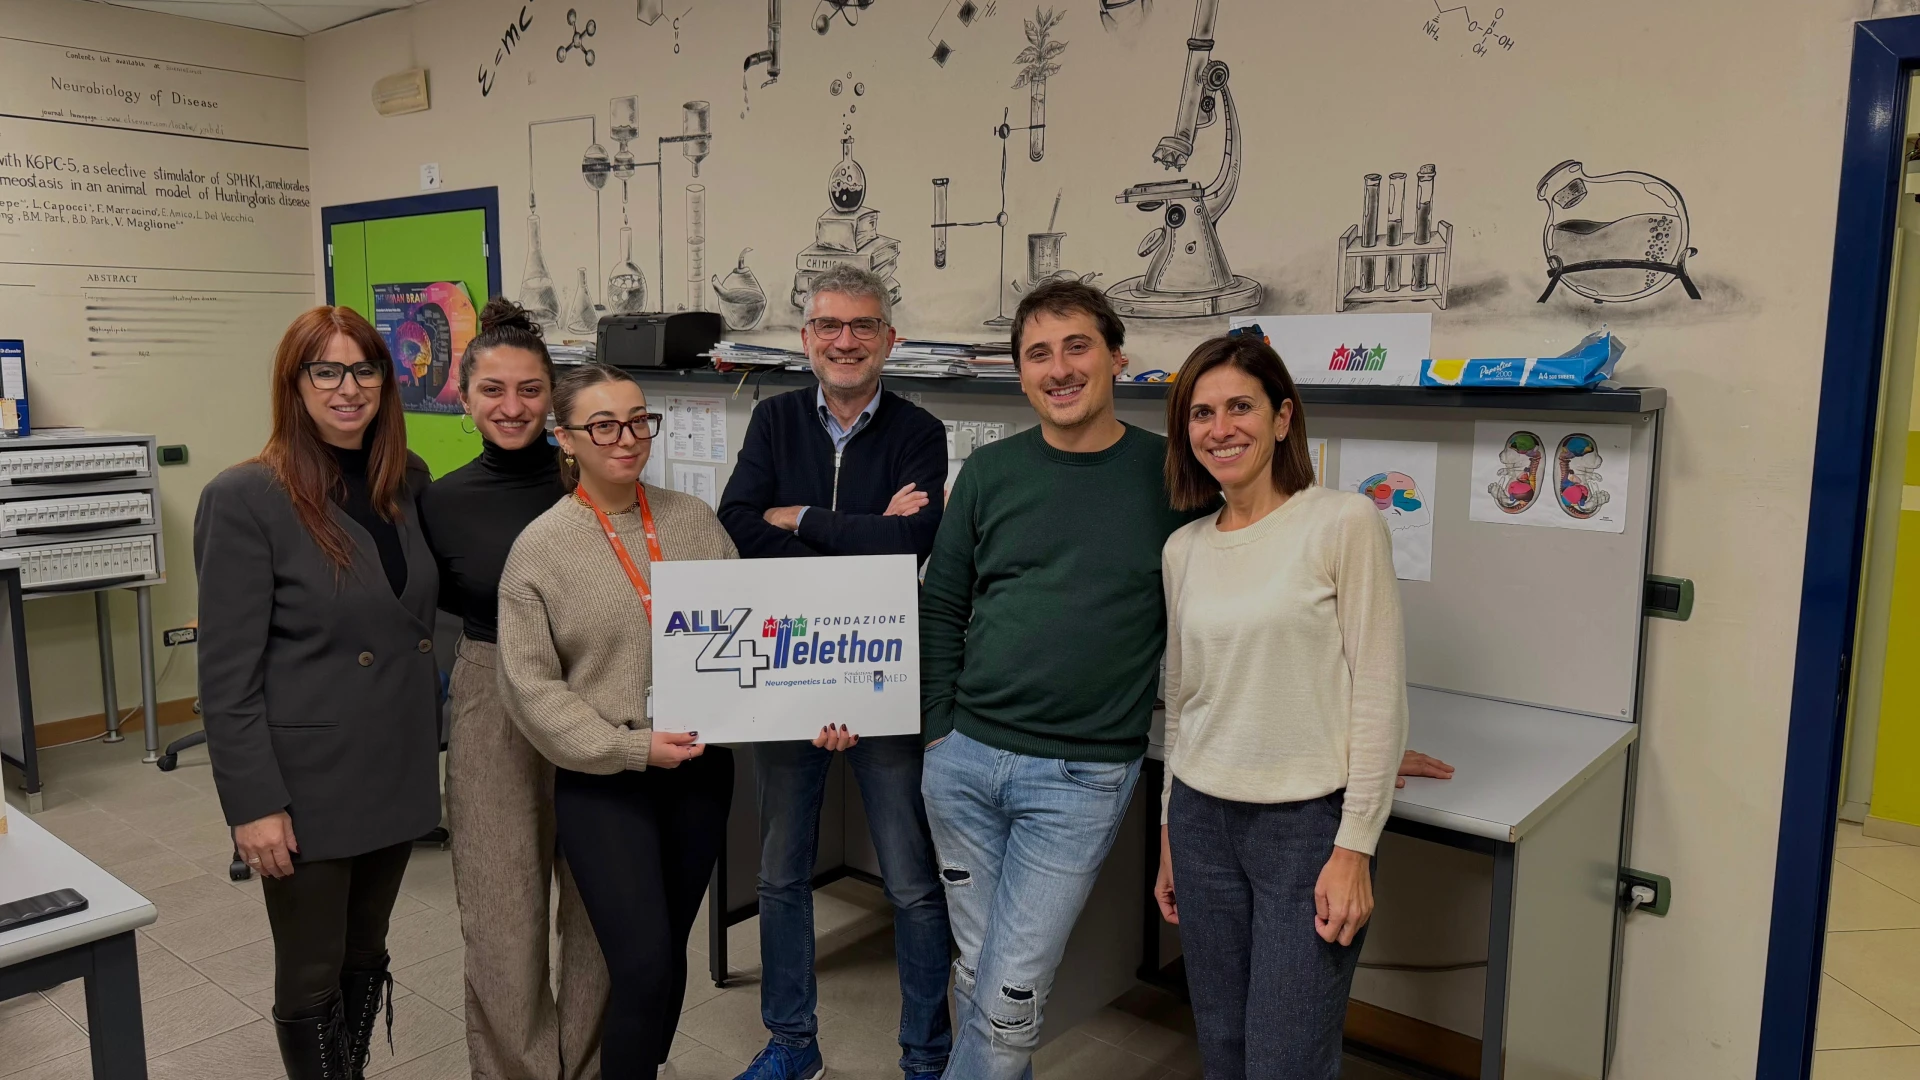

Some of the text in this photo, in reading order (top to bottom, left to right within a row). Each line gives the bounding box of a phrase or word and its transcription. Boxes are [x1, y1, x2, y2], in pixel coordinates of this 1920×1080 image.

[65, 51, 95, 61] Contents
[100, 55, 111, 63] list
[115, 58, 146, 67] available
[51, 76, 219, 109] Neurobiology of Disease
[41, 108, 64, 118] journal
[25, 153, 80, 174] K6PC-5,
[82, 163, 90, 174] a
[93, 162, 147, 179] selective
[153, 167, 206, 184] stimulator
[210, 172, 220, 185] of
[70, 179, 82, 191] in
[86, 182, 102, 193] an
[106, 181, 147, 196] animal
[155, 184, 192, 199] model
[198, 186, 210, 200] of
[278, 192, 311, 208] disease
[806, 258, 843, 269] CHIMIC
[87, 274, 138, 283] ABSTRACT
[406, 293, 428, 304] BRAIN
[1495, 370, 1513, 378] 2000
[1538, 372, 1549, 380] A4
[664, 610, 731, 635] ALL
[814, 614, 907, 626] FONDAZIONE
[696, 608, 770, 688] 4
[772, 624, 903, 669] Telethon
[765, 679, 821, 687] Neurogenetics
